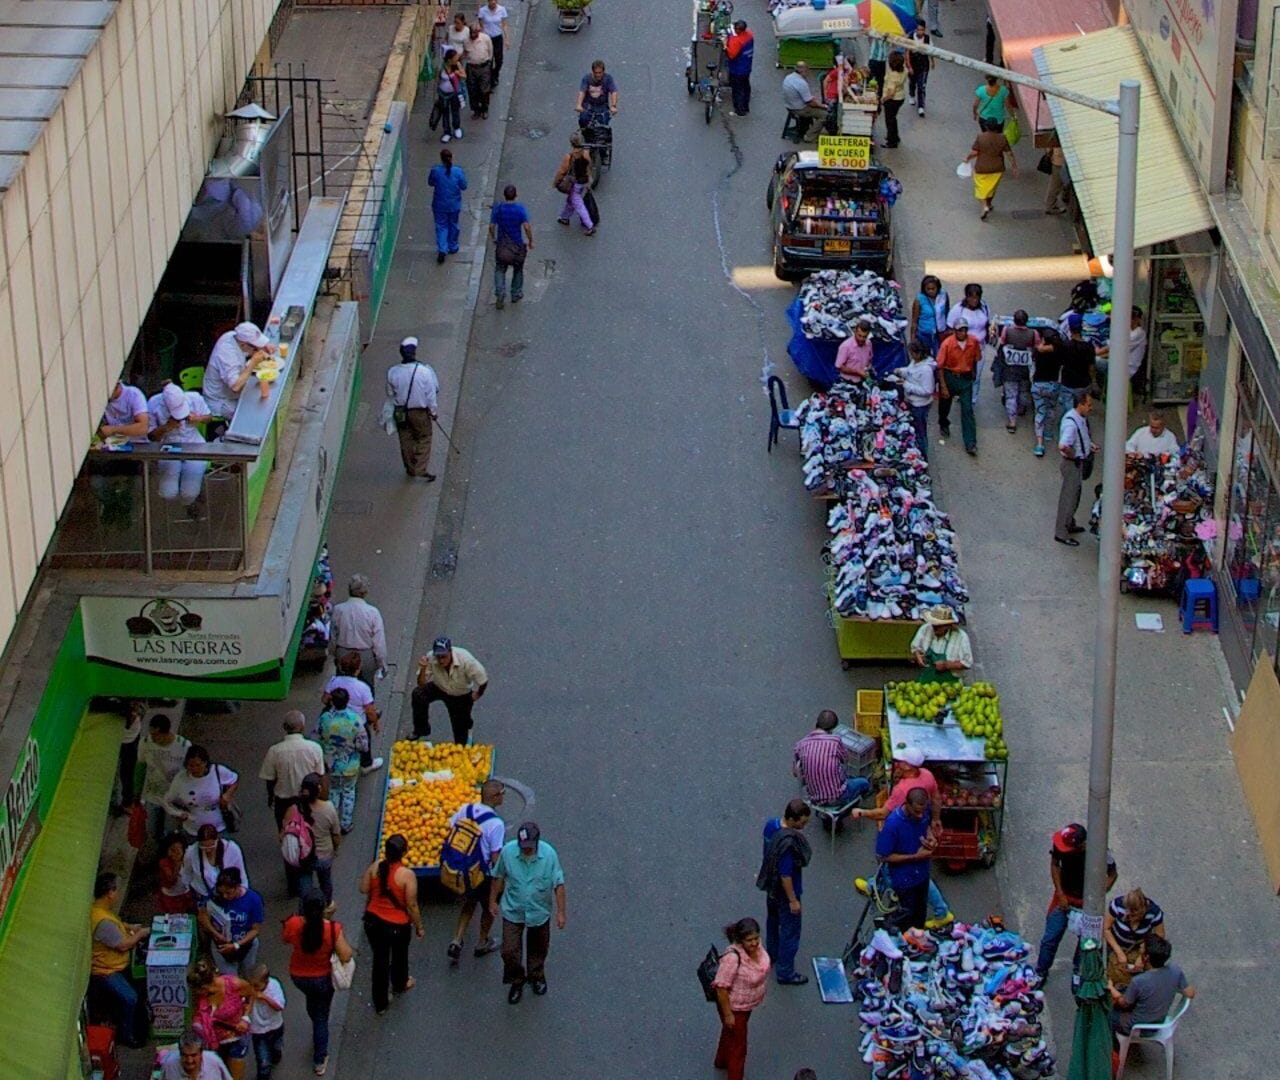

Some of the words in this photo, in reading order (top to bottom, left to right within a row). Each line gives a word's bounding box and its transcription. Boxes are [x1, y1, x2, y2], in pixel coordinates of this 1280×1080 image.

[821, 137, 869, 147] BILLETERAS
[824, 148, 835, 157] EN
[837, 148, 865, 158] CUERO
[822, 158, 866, 168] $6.000
[1006, 350, 1029, 364] 200
[133, 639, 166, 654] LAS
[171, 640, 242, 656] NEGRAS
[136, 656, 238, 666] www.lasnegras.com.co
[149, 984, 187, 1005] 200
